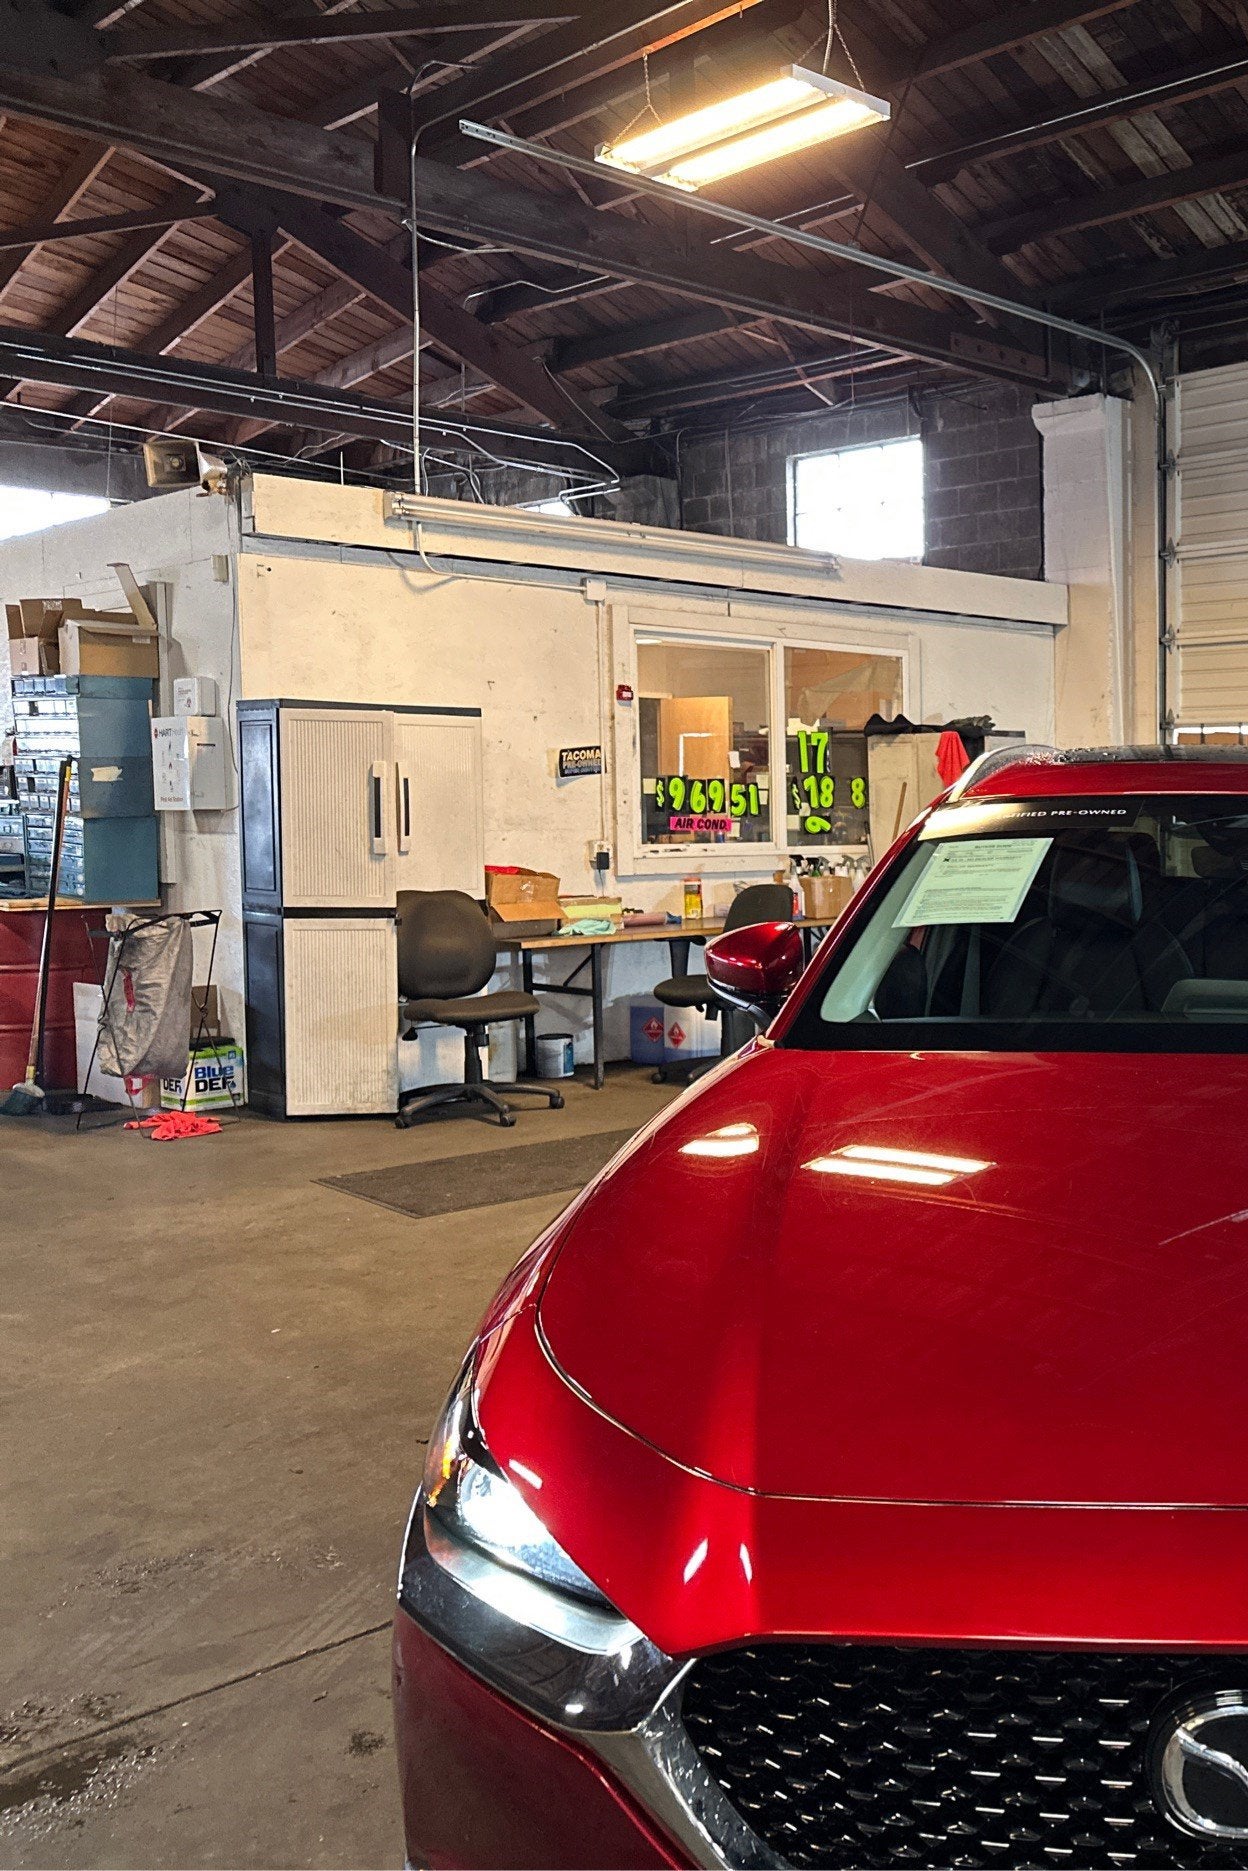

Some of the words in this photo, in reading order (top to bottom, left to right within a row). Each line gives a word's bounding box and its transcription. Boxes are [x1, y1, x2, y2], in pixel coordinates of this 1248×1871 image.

[562, 749, 601, 761] TACOMA
[798, 731, 828, 773] 17
[1002, 811, 1047, 819] TIFIED
[674, 818, 694, 829] AIR
[194, 1065, 234, 1079] Blue
